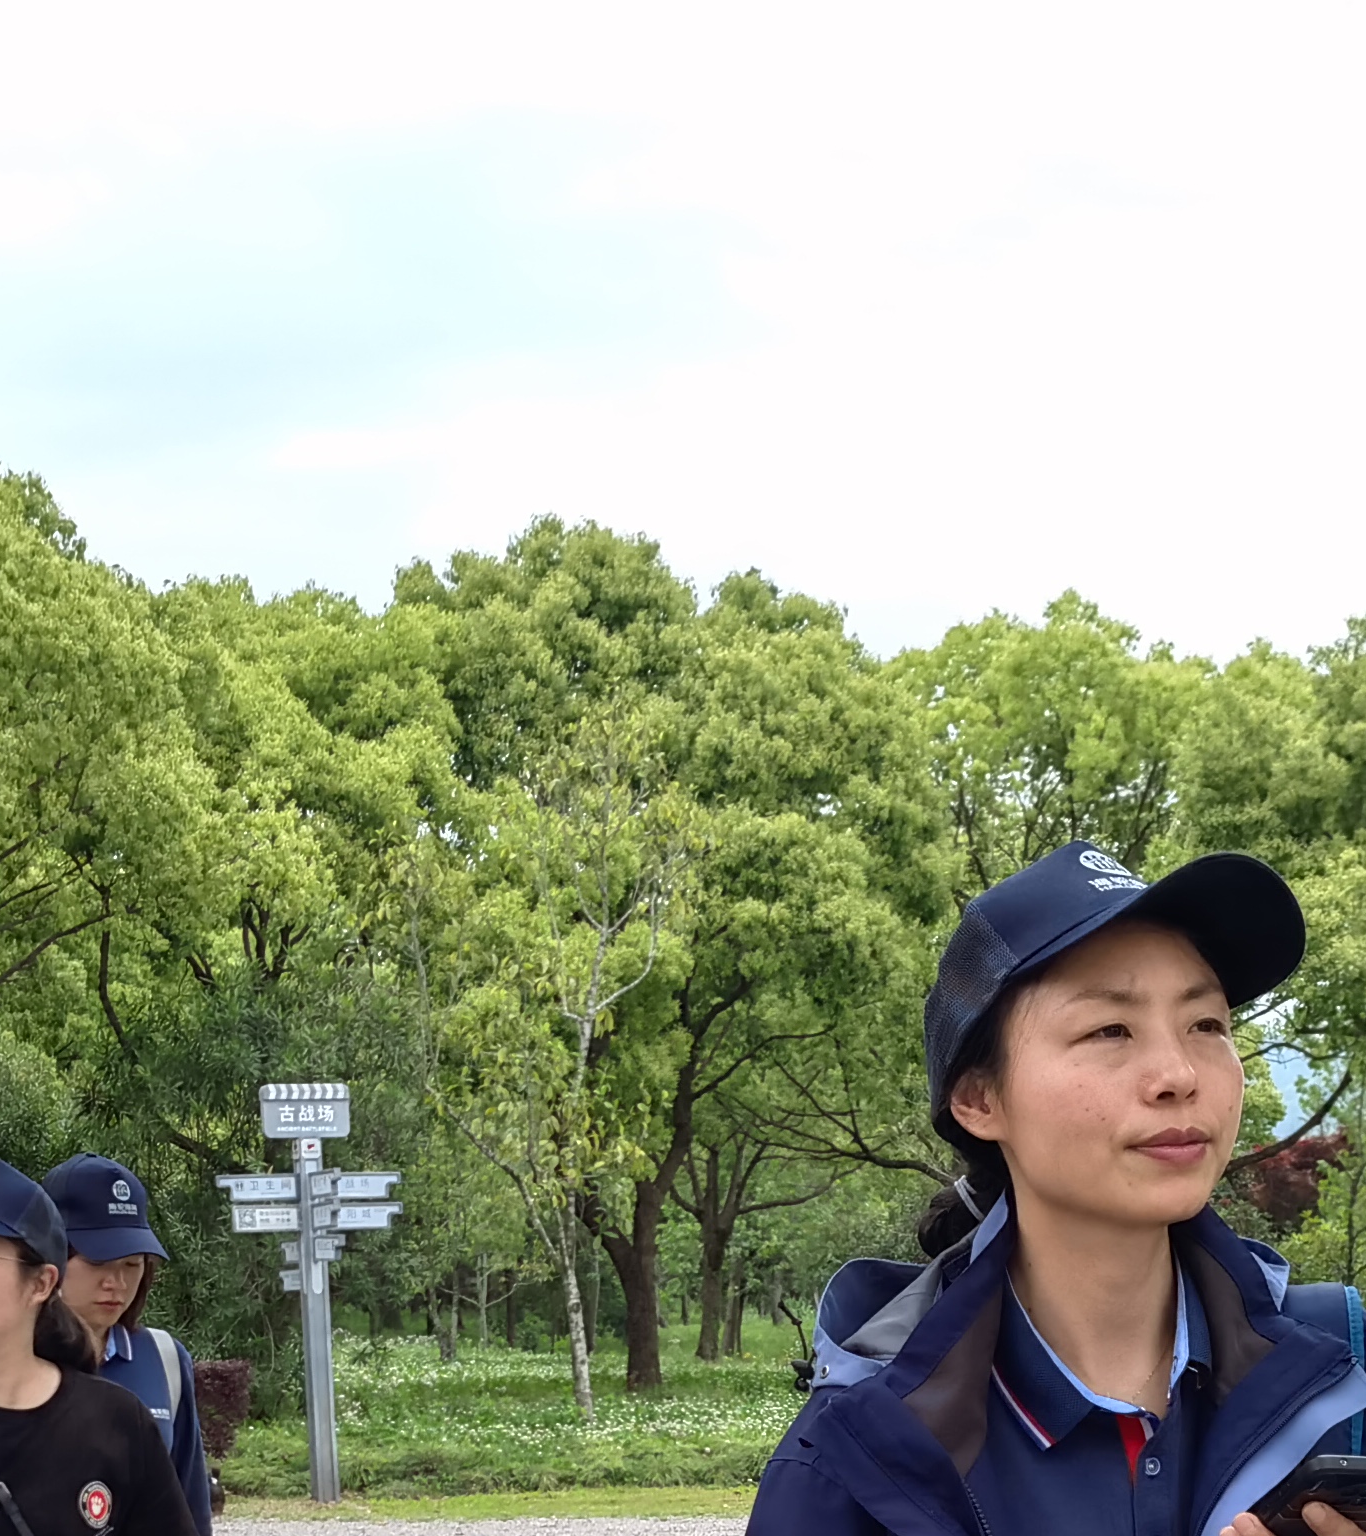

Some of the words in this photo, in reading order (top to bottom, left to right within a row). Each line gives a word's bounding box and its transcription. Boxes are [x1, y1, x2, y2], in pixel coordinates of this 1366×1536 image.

[279, 1104, 334, 1122] 古战场
[249, 1180, 292, 1191] 卫生间
